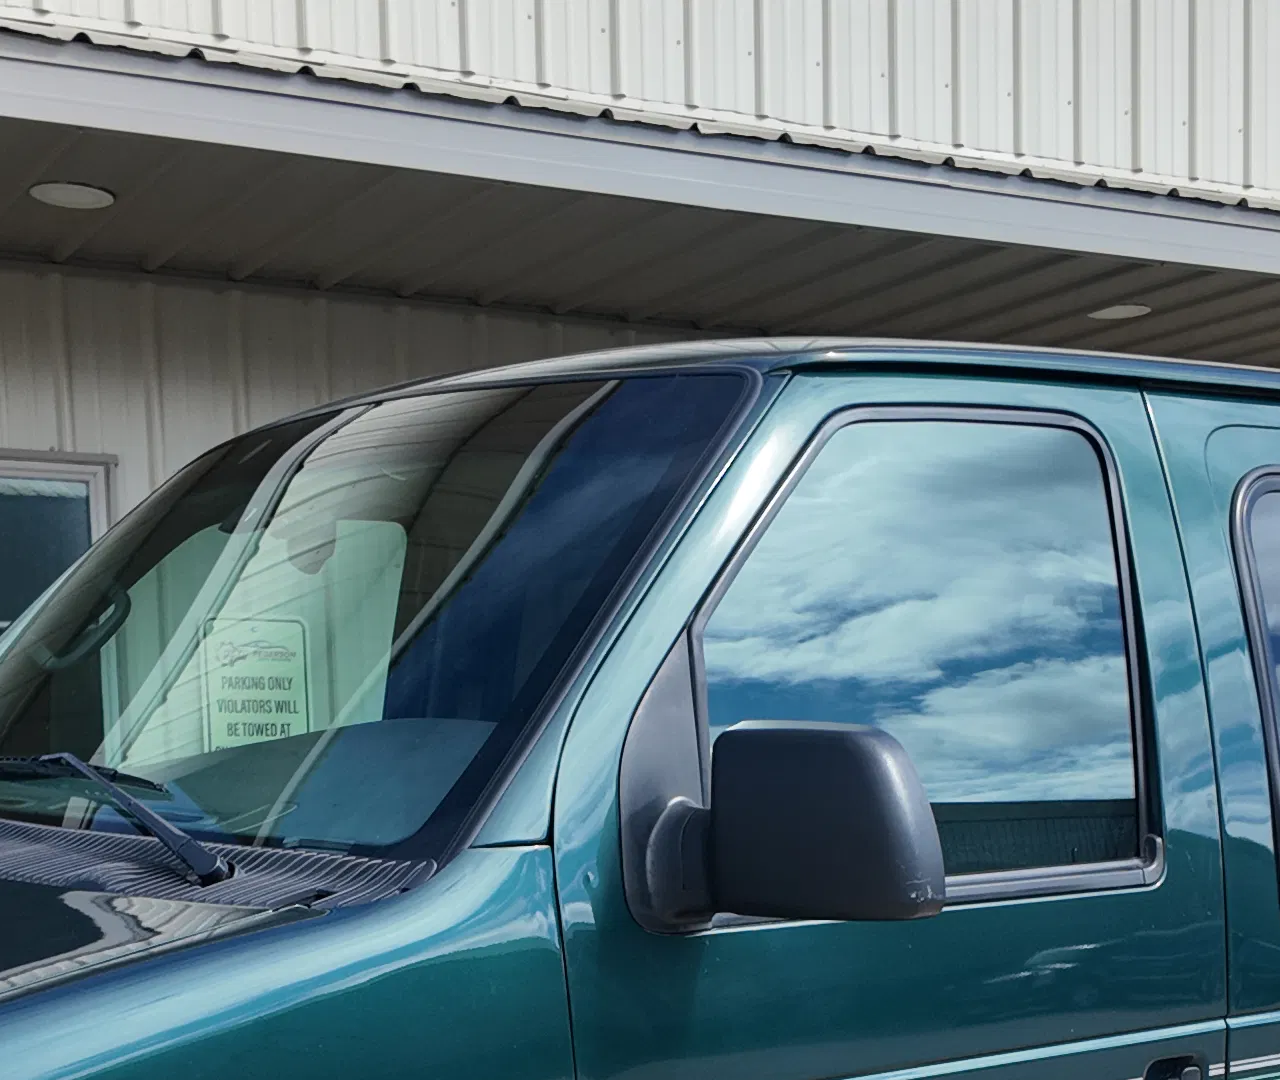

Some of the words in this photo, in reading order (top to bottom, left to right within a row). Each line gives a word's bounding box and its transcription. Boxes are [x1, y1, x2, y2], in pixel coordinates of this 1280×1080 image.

[222, 676, 265, 690] PARKING
[268, 677, 293, 691] ONLY
[216, 699, 272, 714] VIOLATORS
[275, 700, 299, 714] WILL
[227, 722, 239, 737] BE
[242, 722, 277, 737] TOWED
[280, 723, 291, 737] AT
